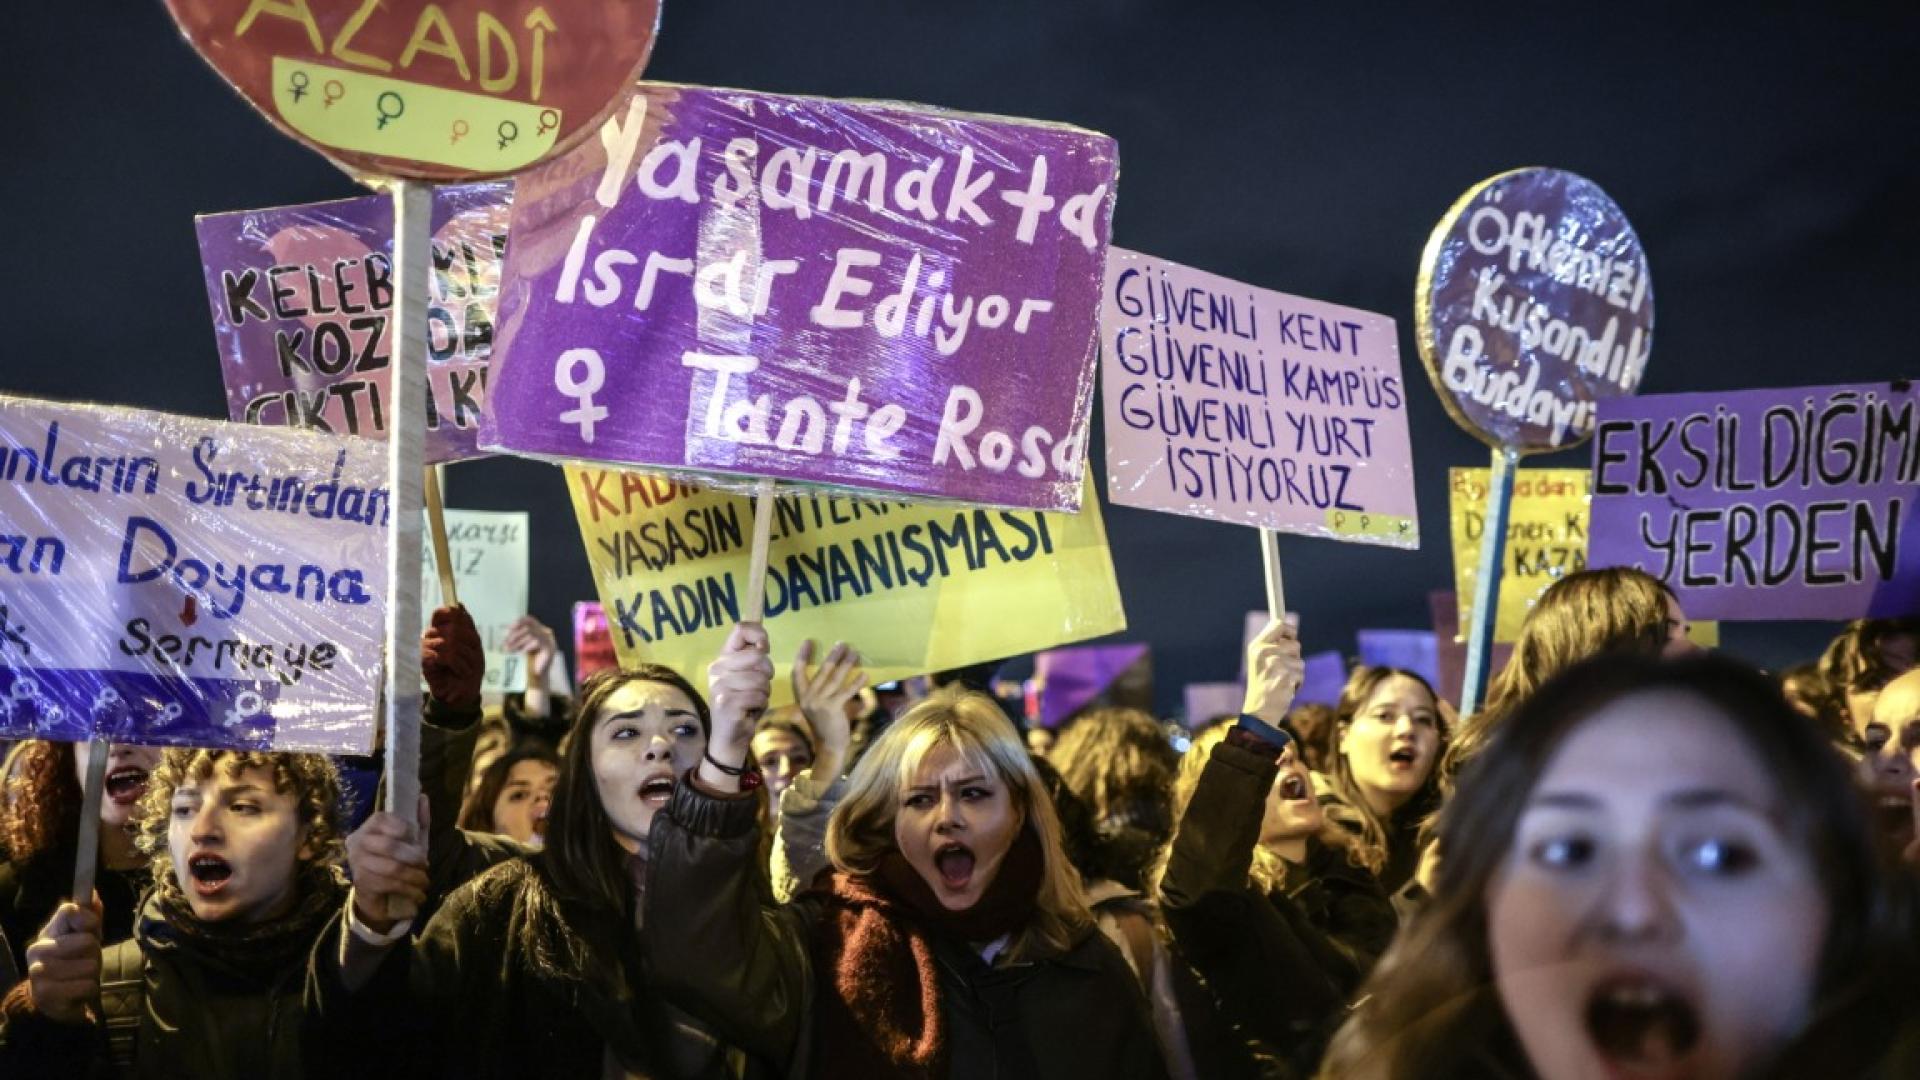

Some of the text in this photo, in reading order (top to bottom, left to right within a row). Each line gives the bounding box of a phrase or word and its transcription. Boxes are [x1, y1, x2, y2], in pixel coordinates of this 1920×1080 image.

[554, 214, 1055, 356] Israr Ediyor
[1115, 264, 1364, 356] GÜVENLİ KENT
[1116, 323, 1402, 410] GÜVENLİ KAMPÜS
[681, 350, 1088, 480] Tante Rosa
[1119, 382, 1376, 458] GÜVENLİ YURT
[1166, 437, 1364, 512] İSTİYORUZ
[118, 516, 372, 620] Doyana
[598, 502, 743, 579] YAŞASIN
[1642, 500, 1900, 586] YERDEN
[120, 617, 338, 687] Sermaye
[614, 572, 740, 648] KADIN
